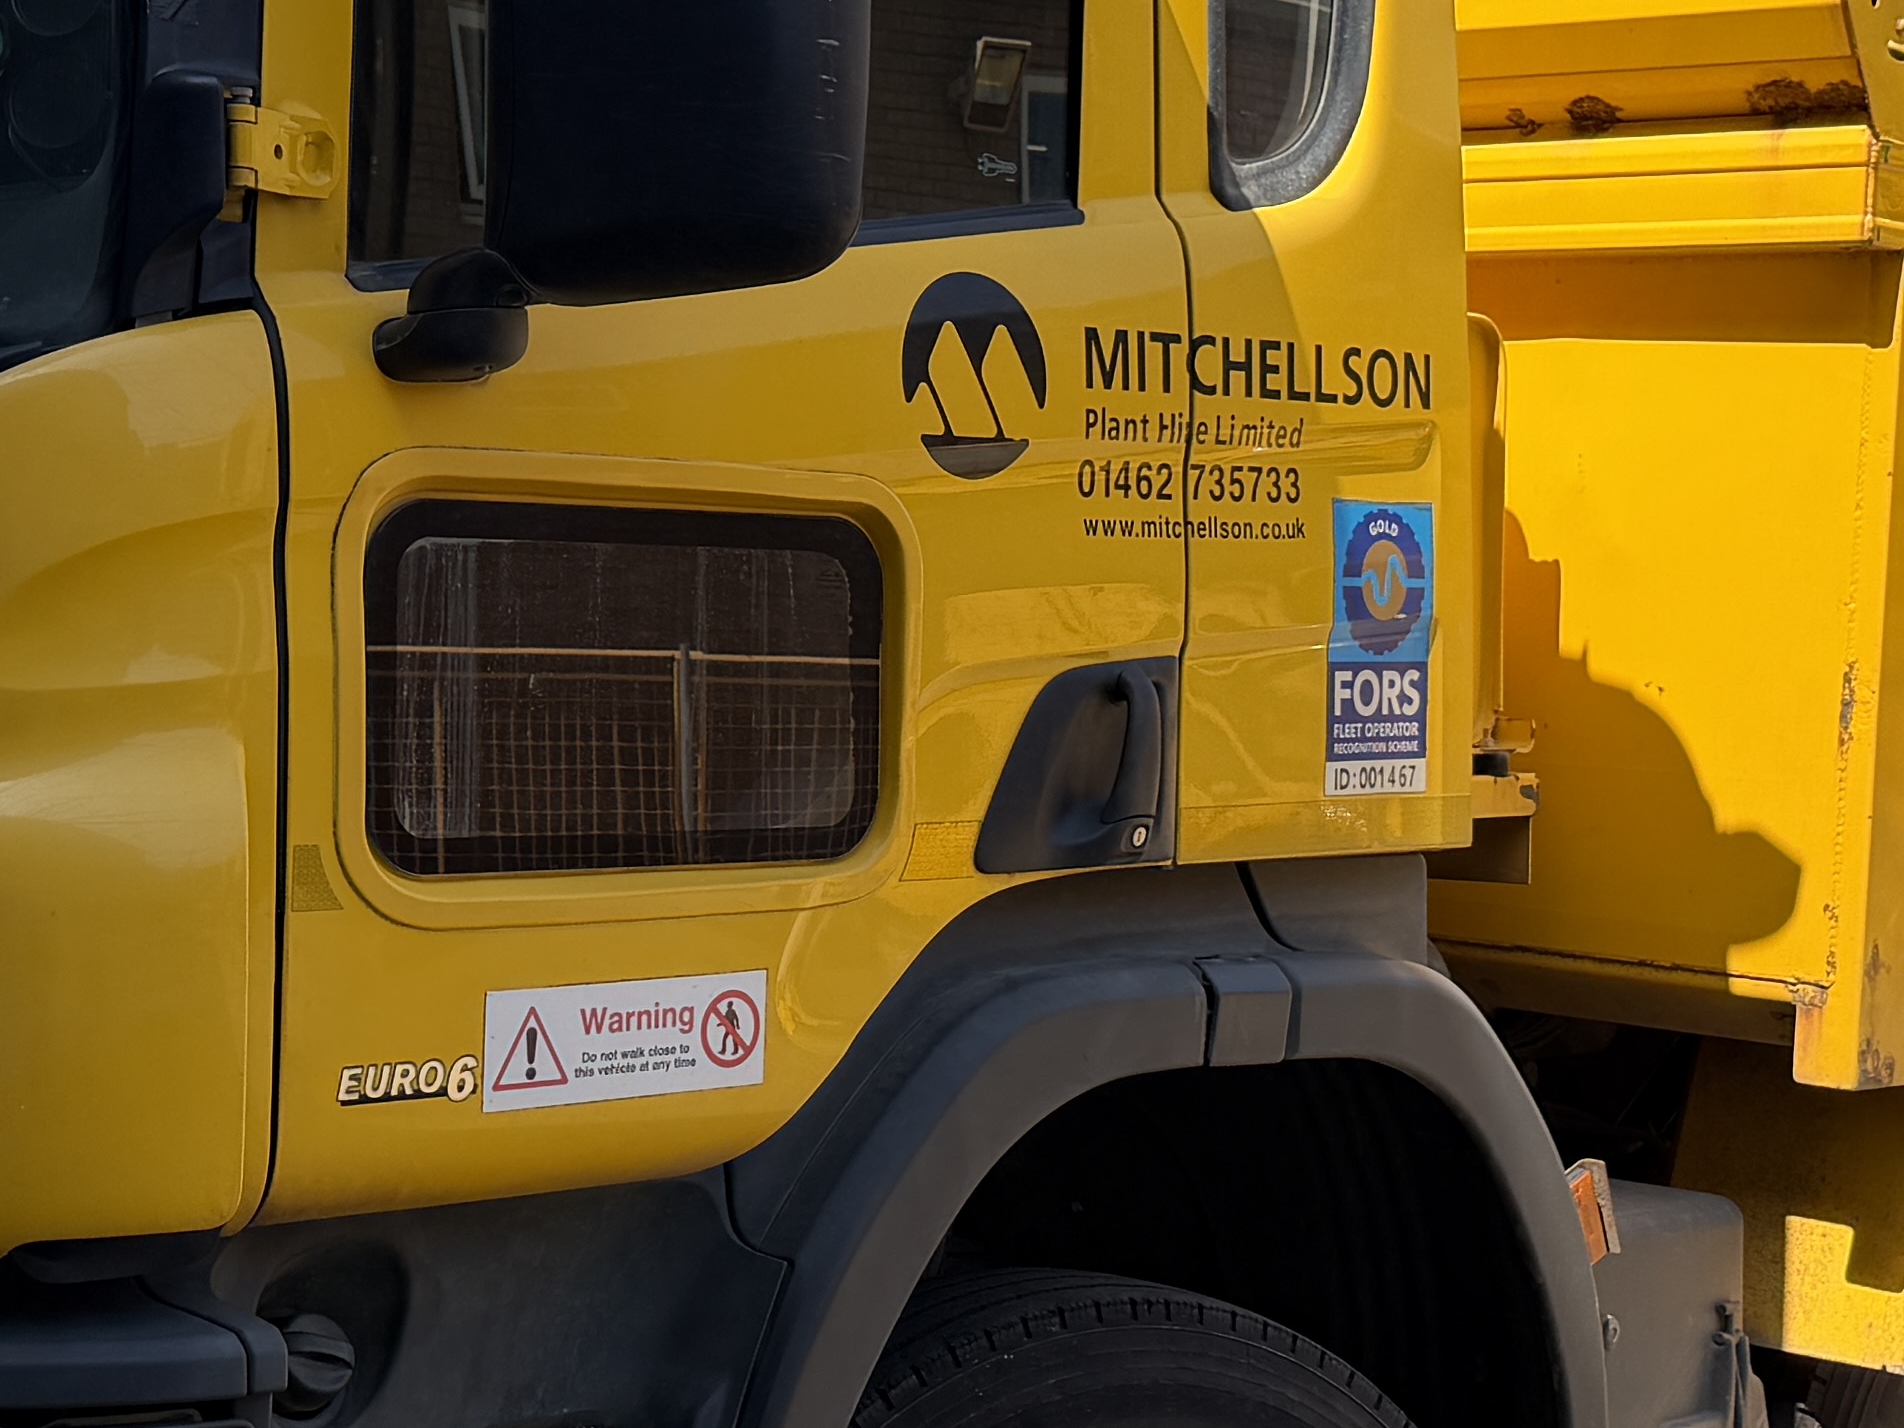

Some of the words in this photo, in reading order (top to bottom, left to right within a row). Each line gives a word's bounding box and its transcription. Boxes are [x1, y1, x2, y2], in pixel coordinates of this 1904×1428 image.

[1084, 325, 1431, 410] MITCHELLSON
[1084, 406, 1149, 443] Plant
[1214, 414, 1305, 450] Limited
[1077, 459, 1173, 501] 01462
[1188, 463, 1302, 504] 735733
[1082, 514, 1307, 540] www.mitchellson.co.uk
[1368, 519, 1399, 537] GOLD
[1333, 668, 1422, 717] FORS
[1333, 722, 1363, 739] FLEET
[1364, 721, 1419, 738] OPERATOR
[580, 1001, 695, 1035] Warning
[574, 1066, 595, 1078] this
[597, 1062, 637, 1076] vehicle
[639, 1061, 650, 1072] at
[652, 1060, 672, 1073] any
[674, 1056, 697, 1069] time
[582, 1052, 598, 1064] Do
[600, 1049, 618, 1062] not
[620, 1047, 646, 1060] walk
[648, 1045, 677, 1057] close
[679, 1044, 690, 1054] to
[337, 1054, 479, 1104] EURO6
